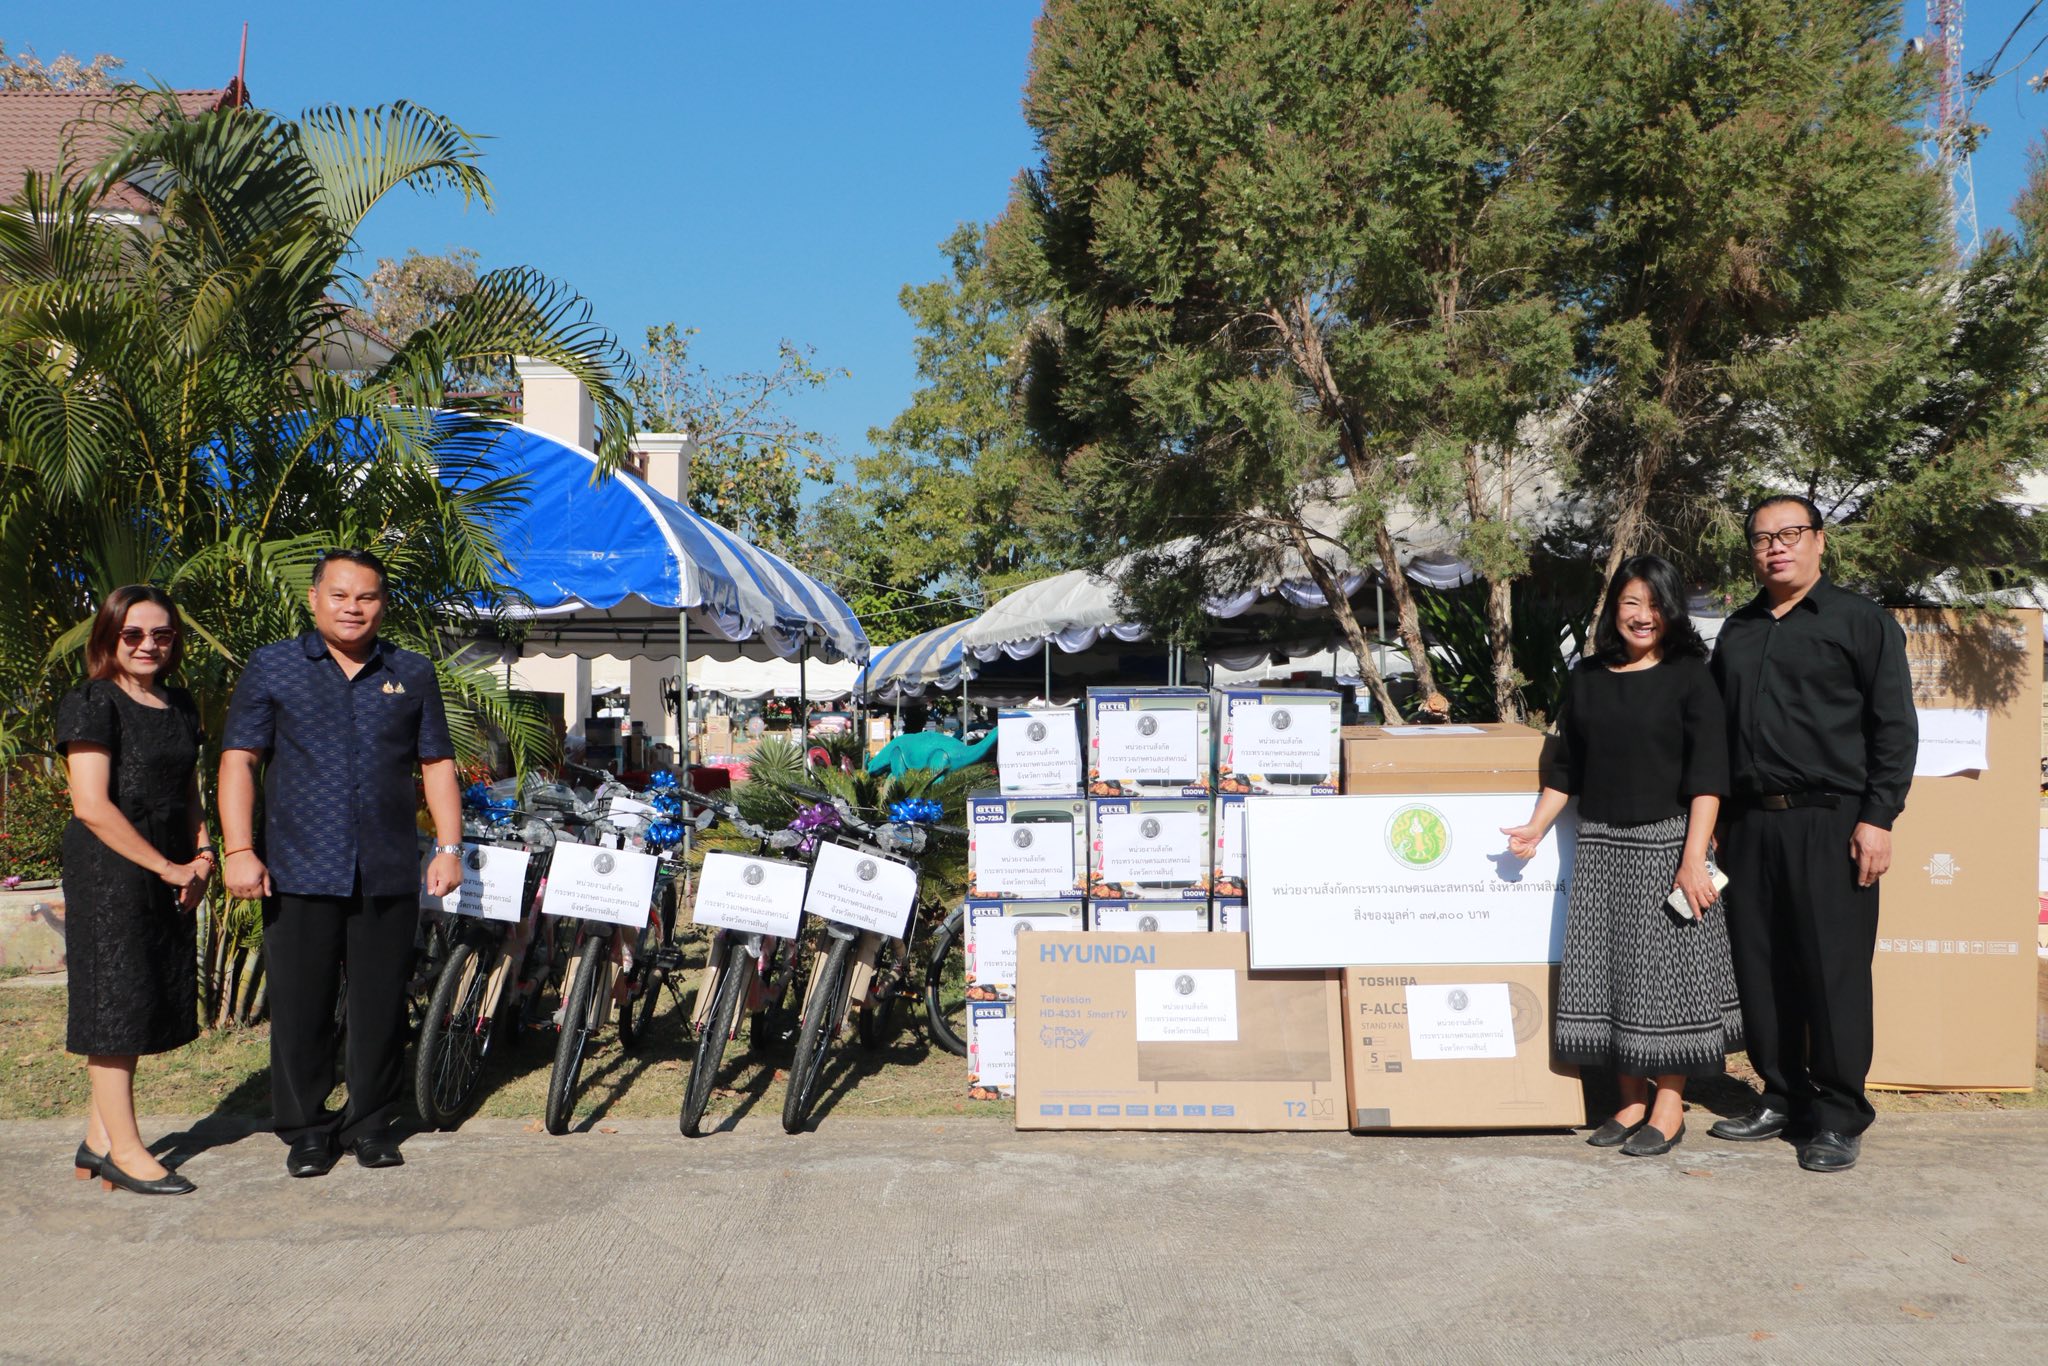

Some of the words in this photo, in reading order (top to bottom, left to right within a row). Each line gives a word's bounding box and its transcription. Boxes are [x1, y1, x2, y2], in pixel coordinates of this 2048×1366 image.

[1182, 788, 1205, 796] 1300W
[1312, 787, 1334, 795] 1300W
[1353, 906, 1416, 925] สิ่งของมูลค่า
[1468, 910, 1490, 920] บาท
[1040, 943, 1156, 964] HYUNDAI
[1358, 977, 1417, 986] TOSHIBA
[1040, 995, 1092, 1004] Television
[1039, 1009, 1082, 1018] HD-4331
[1087, 1010, 1114, 1019] Smart
[1115, 1010, 1128, 1018] TV
[1361, 1022, 1387, 1030] STAND
[1371, 1053, 1378, 1063] 5
[1283, 1101, 1307, 1117] T2
